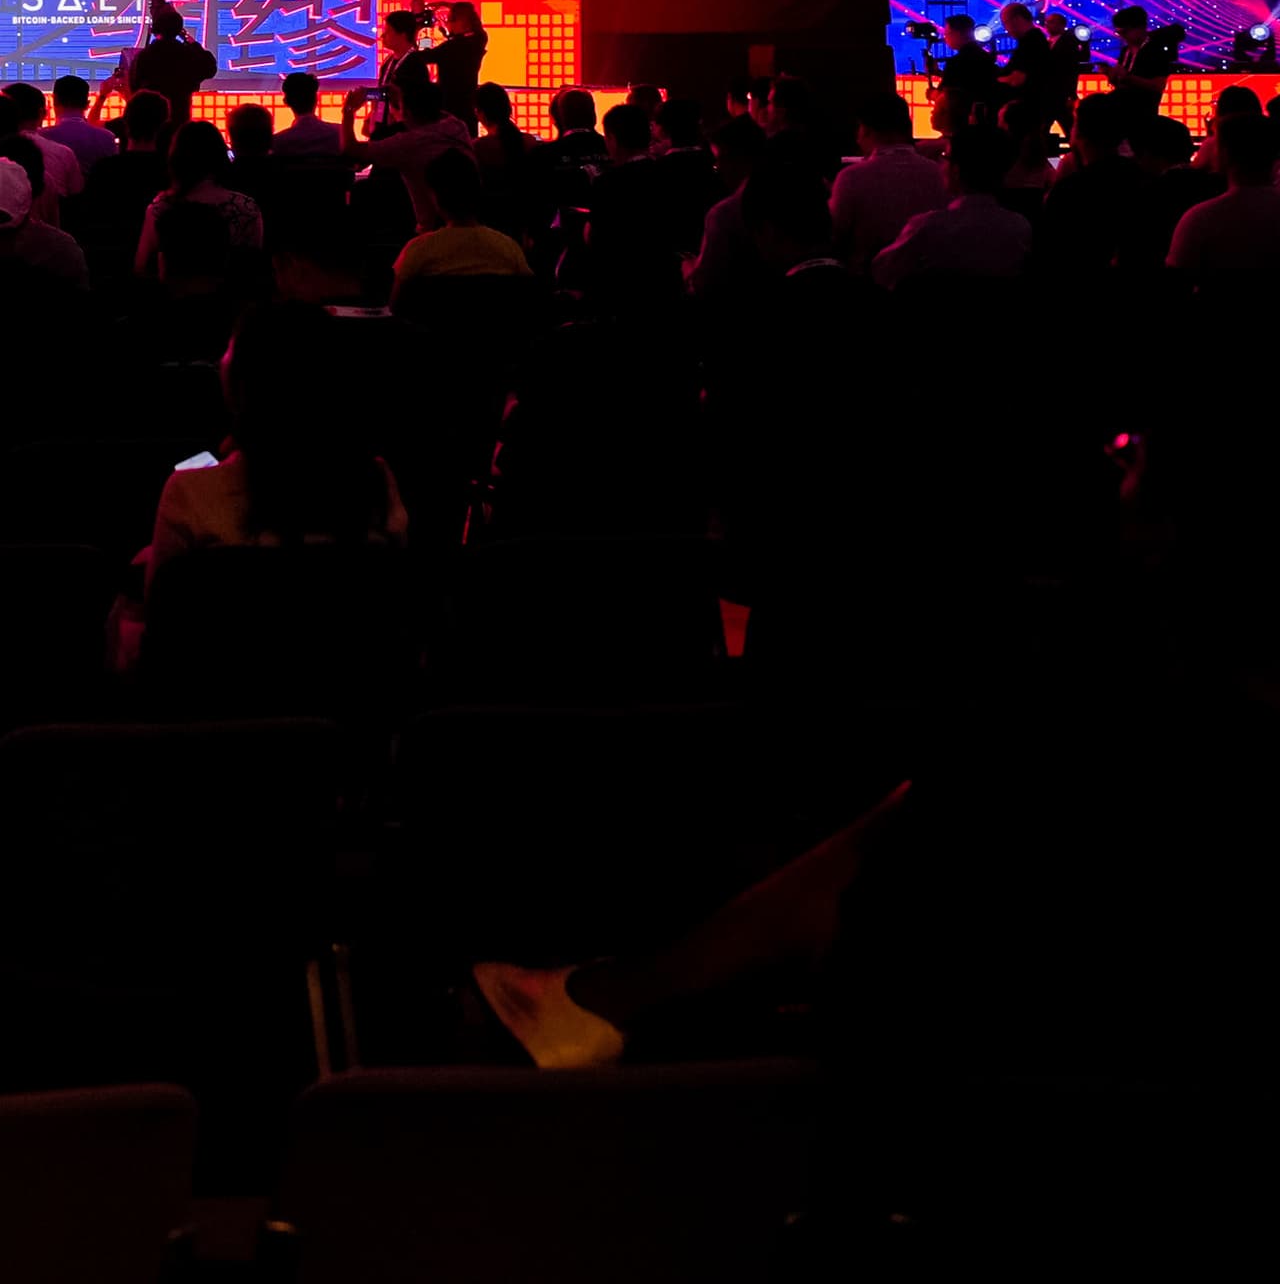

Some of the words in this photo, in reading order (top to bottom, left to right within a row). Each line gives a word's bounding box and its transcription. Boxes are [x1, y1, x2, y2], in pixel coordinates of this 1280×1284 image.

[12, 16, 85, 24] BITCOIN-BACKED
[87, 16, 116, 24] LOANS
[117, 16, 143, 24] SINCE
